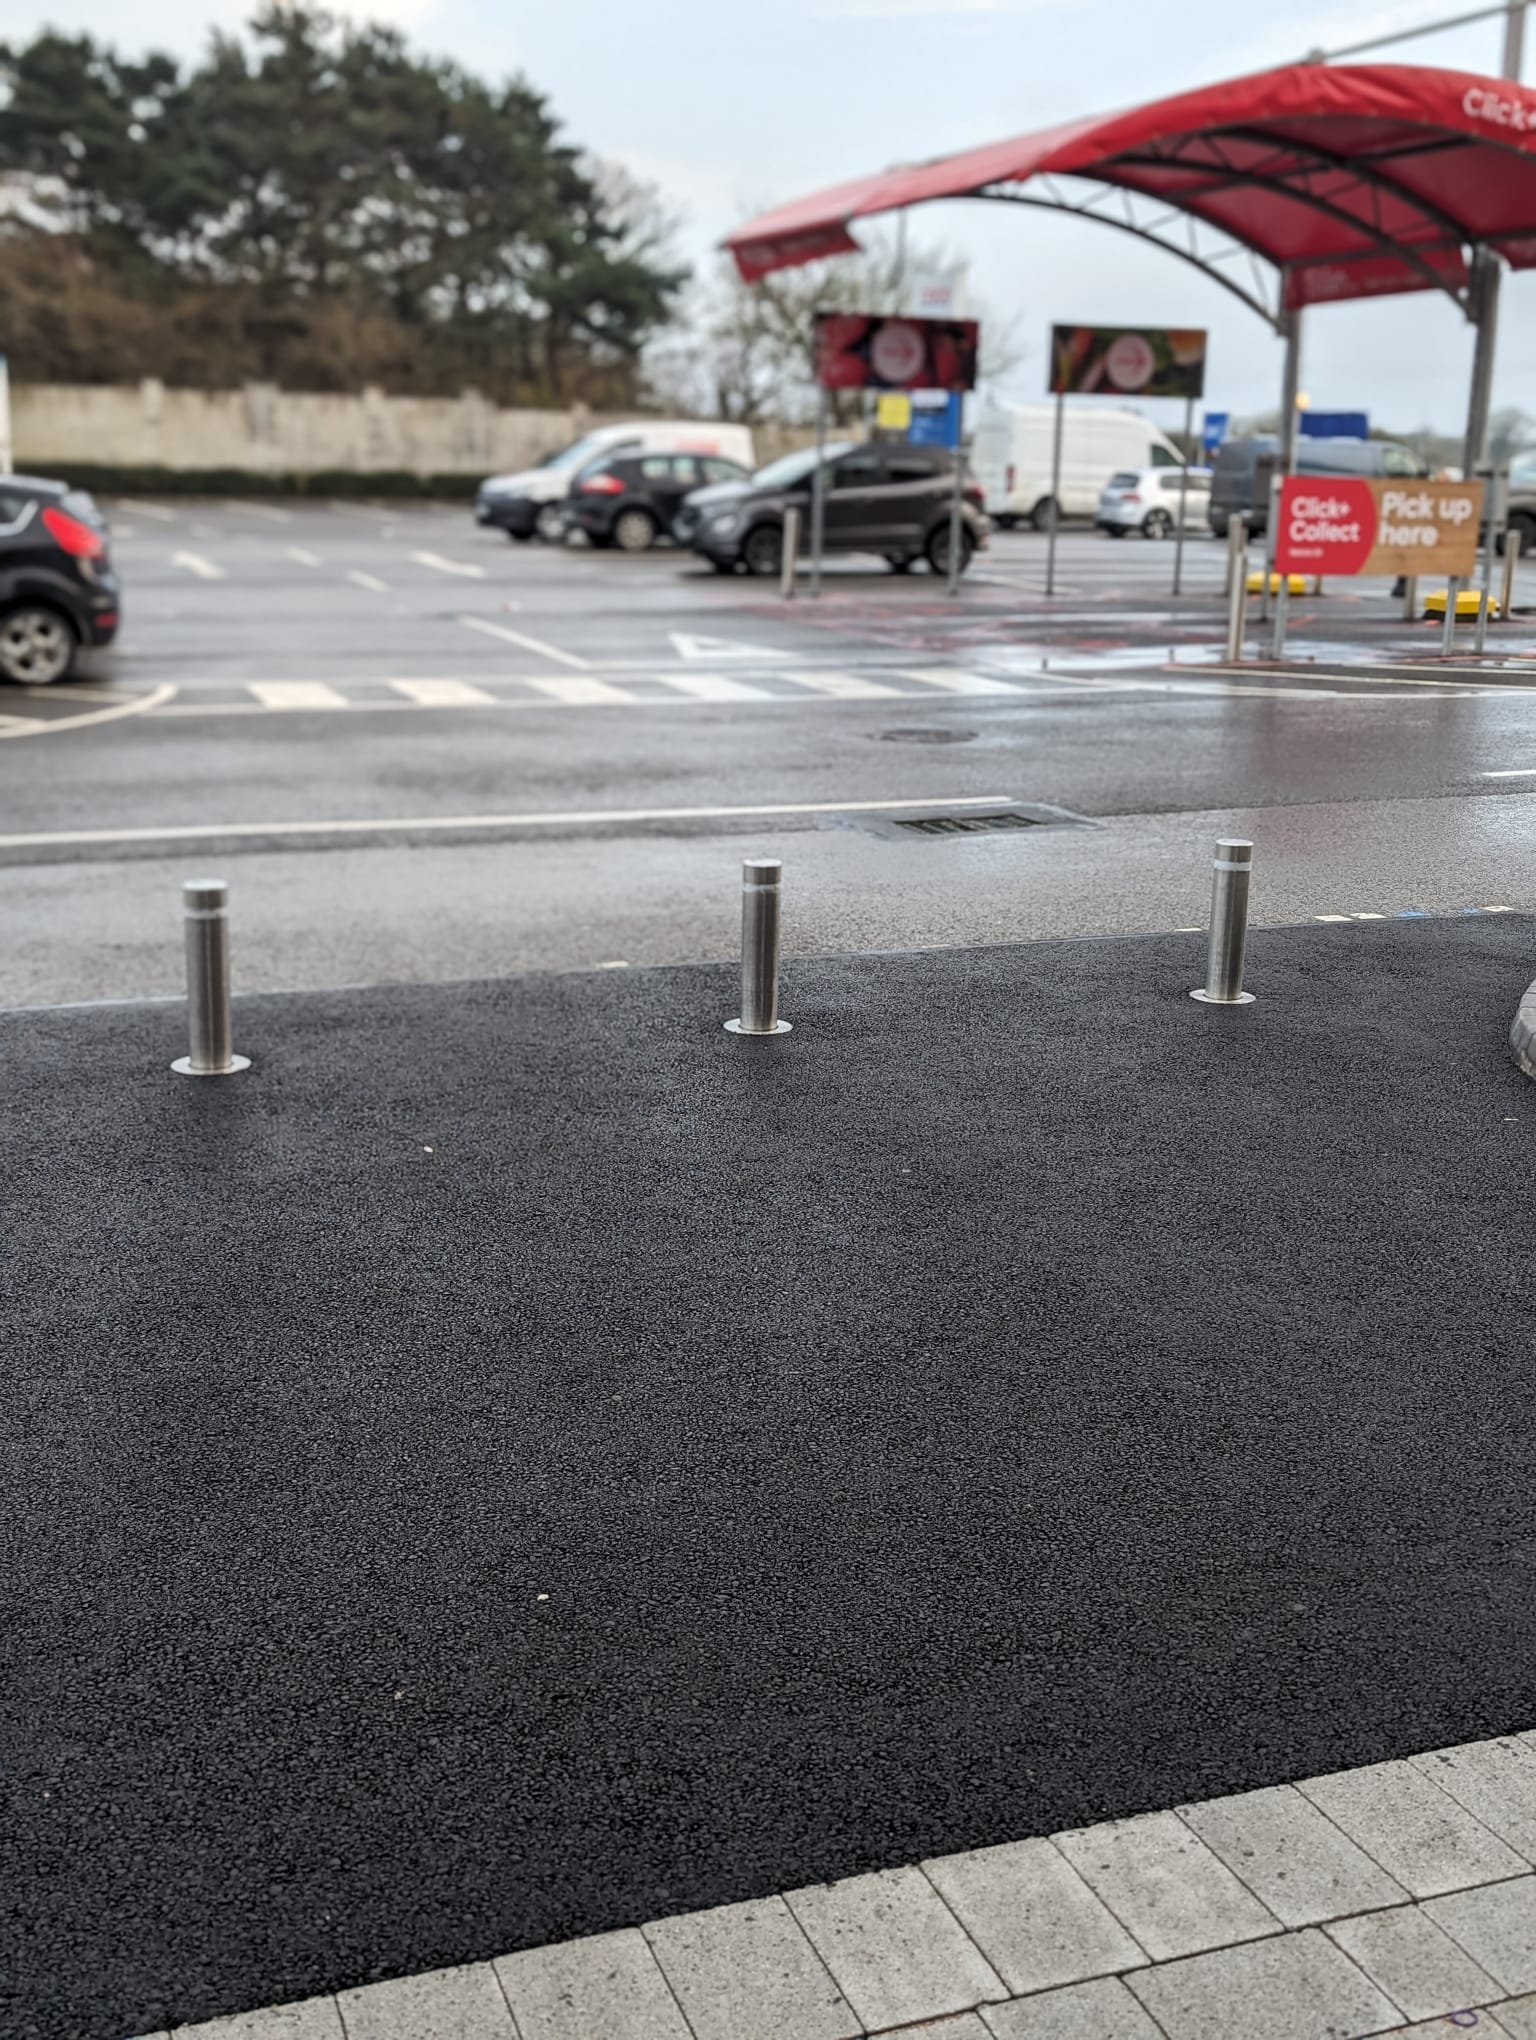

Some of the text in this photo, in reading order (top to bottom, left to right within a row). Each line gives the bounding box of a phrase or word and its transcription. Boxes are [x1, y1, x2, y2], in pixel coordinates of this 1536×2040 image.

[1381, 491, 1472, 526] Pick up
[1289, 520, 1360, 543] Collect
[1378, 522, 1438, 547] here
